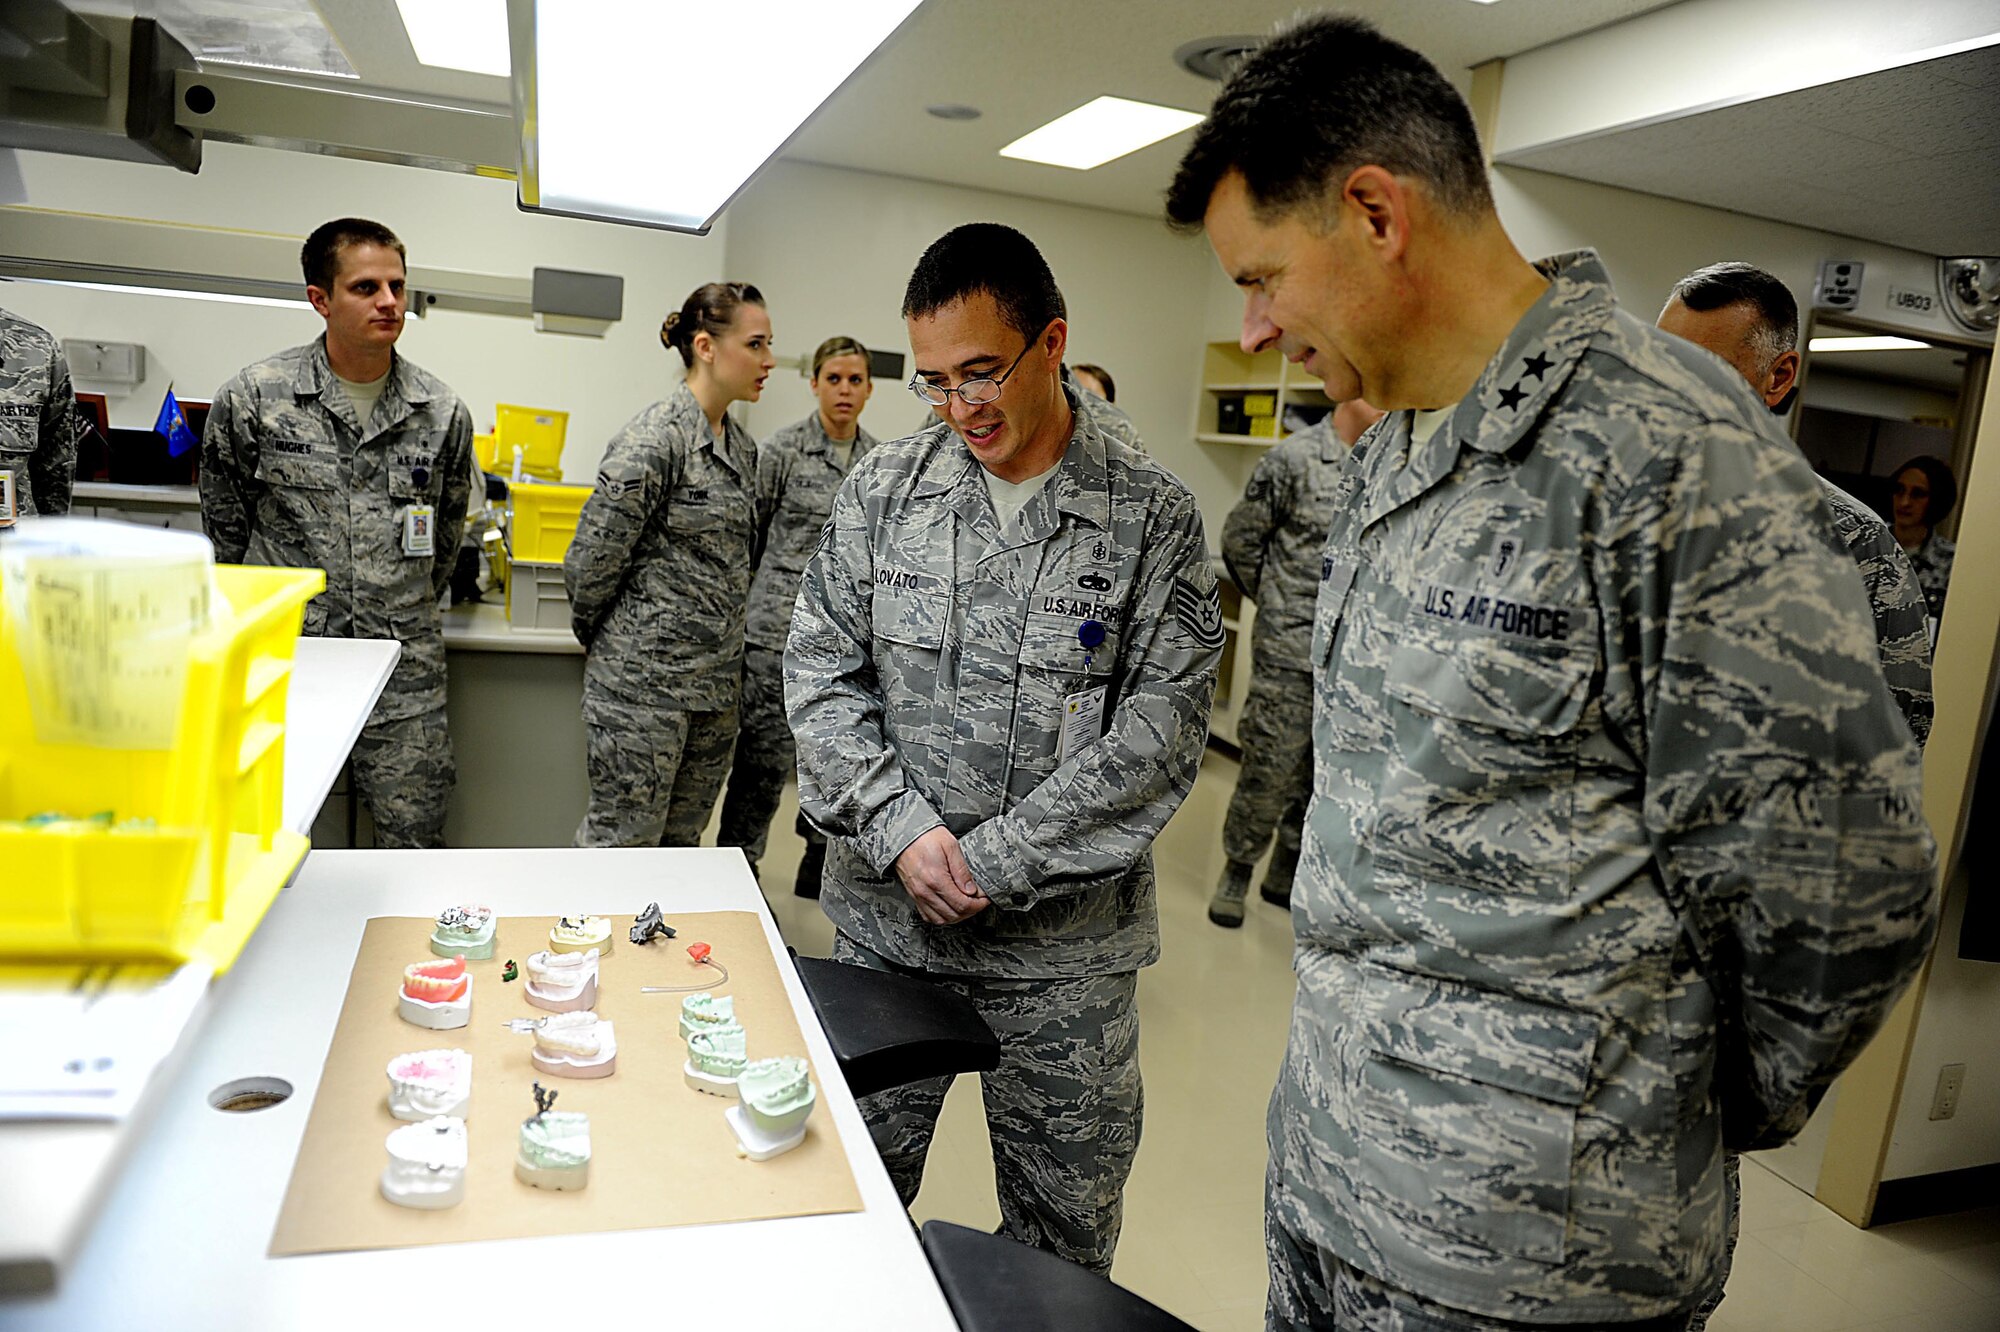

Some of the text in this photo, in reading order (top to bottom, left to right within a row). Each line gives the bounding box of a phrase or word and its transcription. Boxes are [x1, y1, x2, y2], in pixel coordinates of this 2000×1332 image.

[276, 440, 311, 455] HUGHES
[688, 489, 708, 500] YORK
[875, 568, 918, 589] LOVATO
[1043, 596, 1067, 615] U.S.
[1069, 600, 1092, 619] AIR
[1425, 586, 1454, 619] U.S.
[1490, 600, 1569, 640] FORCE
